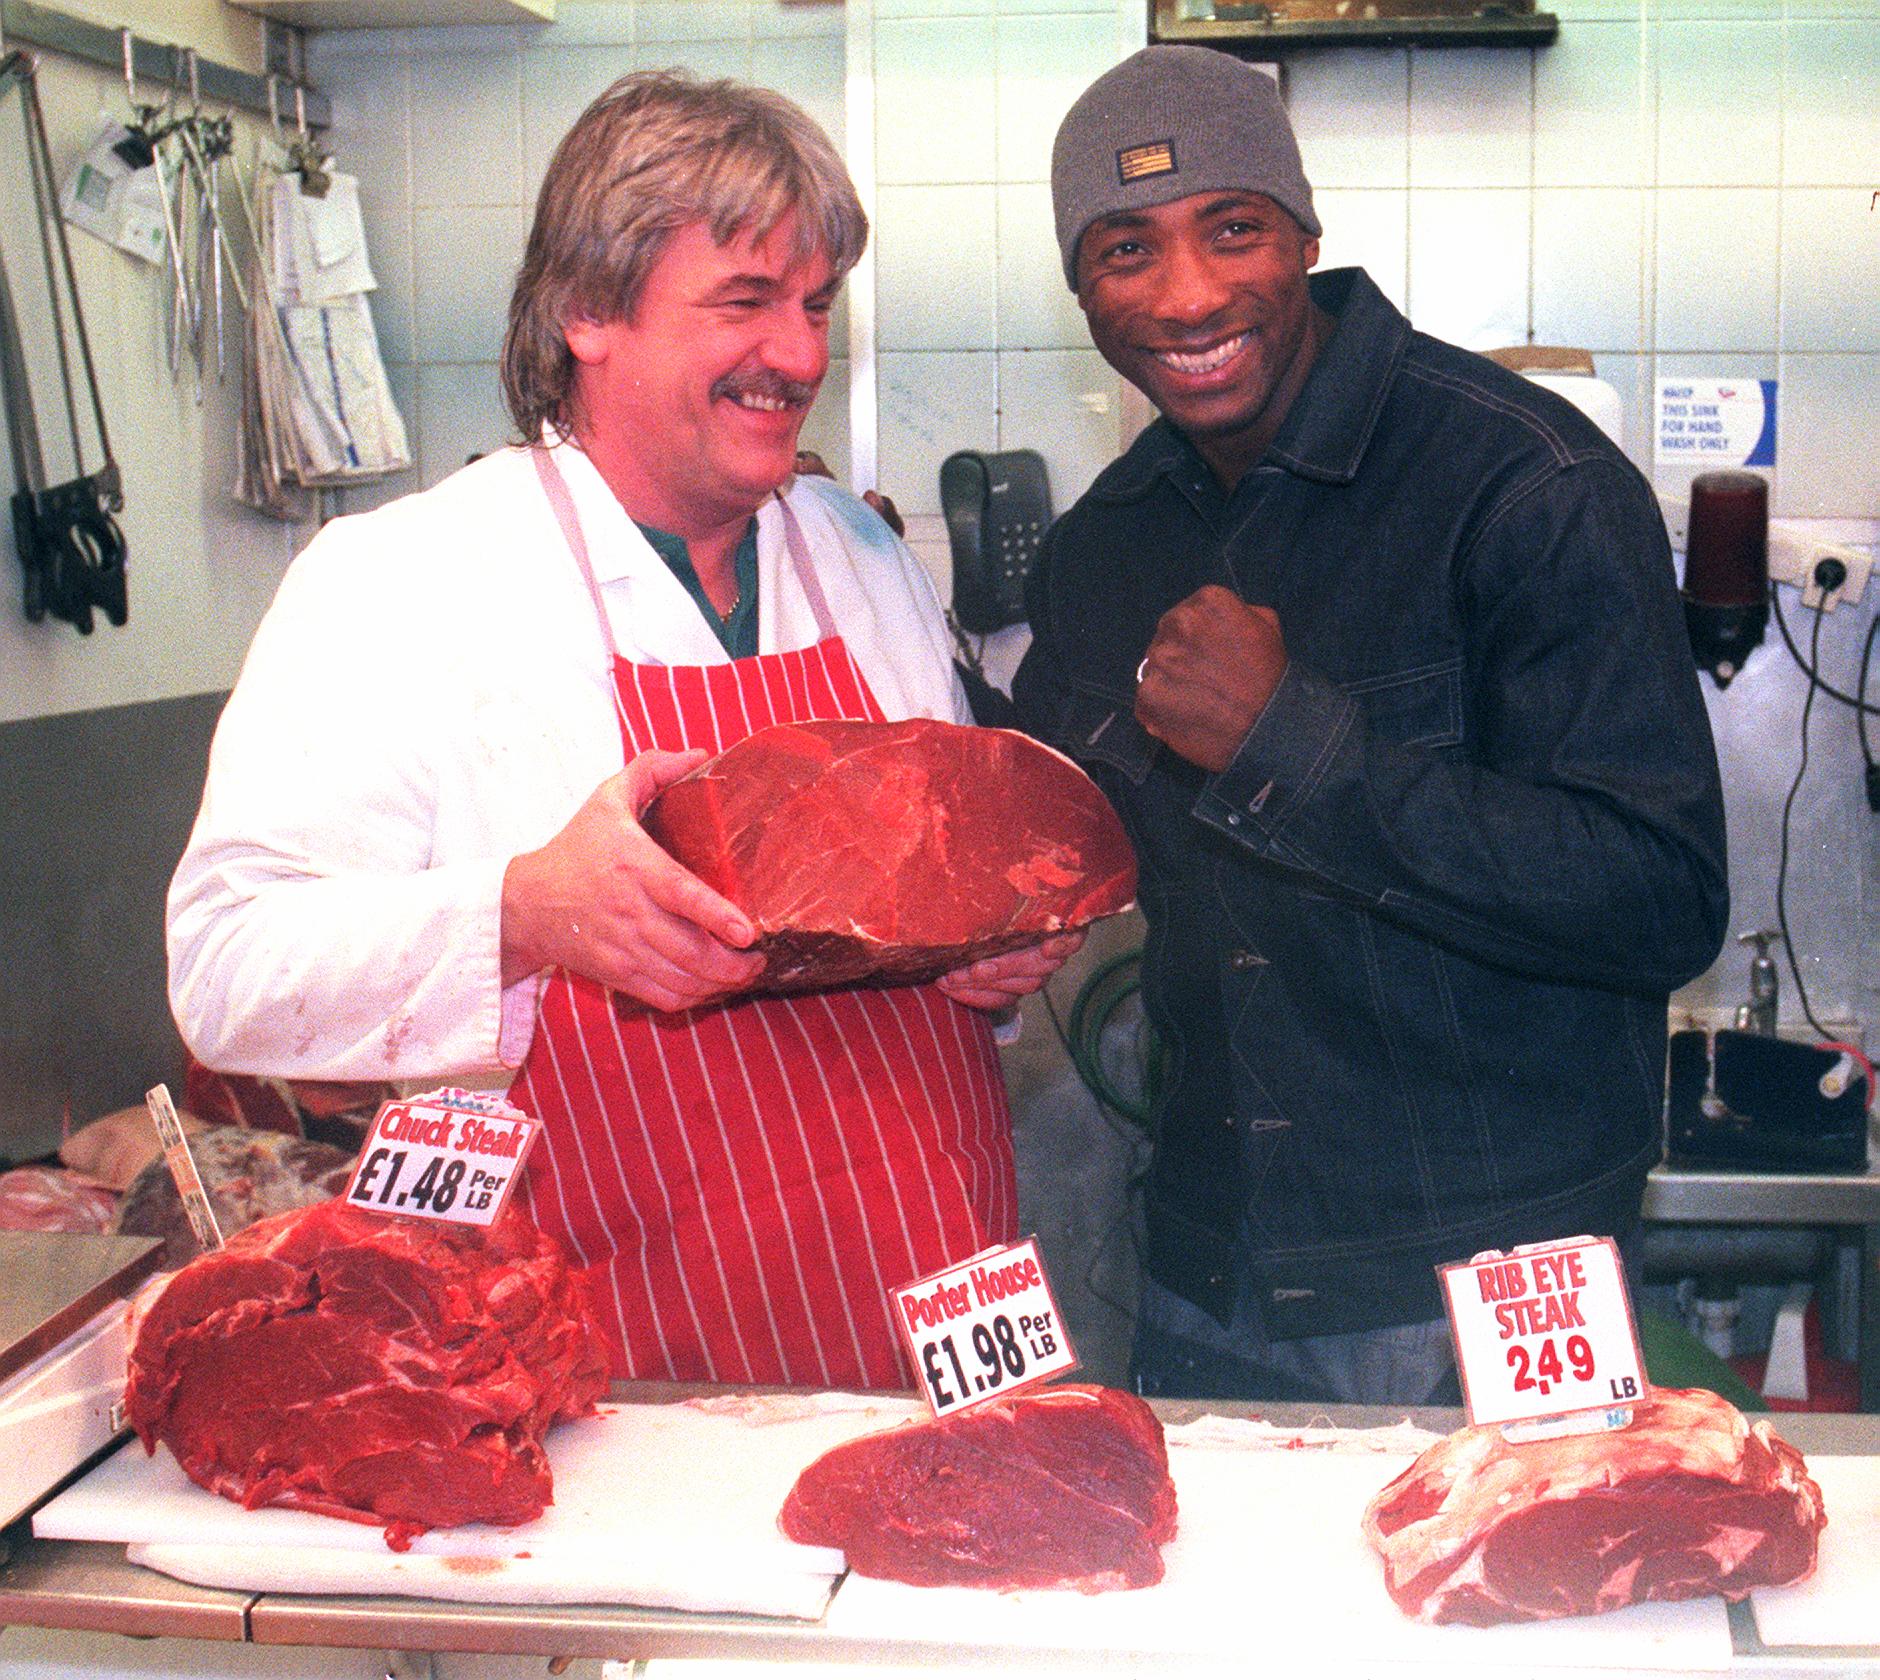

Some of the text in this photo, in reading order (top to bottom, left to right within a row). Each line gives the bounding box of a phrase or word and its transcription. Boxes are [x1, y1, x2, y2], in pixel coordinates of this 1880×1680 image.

[1661, 420, 1723, 433] FOR HAND
[1662, 404, 1719, 416] THIS SINK
[1661, 437, 1729, 450] WASH ONLY
[379, 1107, 525, 1158] Chuck Steak
[351, 1147, 507, 1214] £1.48 Per
[464, 1190, 492, 1210] LB
[901, 1258, 1041, 1333] Porter House
[1476, 1251, 1587, 1303] RIB EYE
[1495, 1291, 1587, 1340] STEAK
[922, 1311, 1052, 1409] £1.98 Per
[1030, 1333, 1058, 1360] LB
[1507, 1334, 1595, 1395] 2.49
[1610, 1377, 1638, 1400] LB
